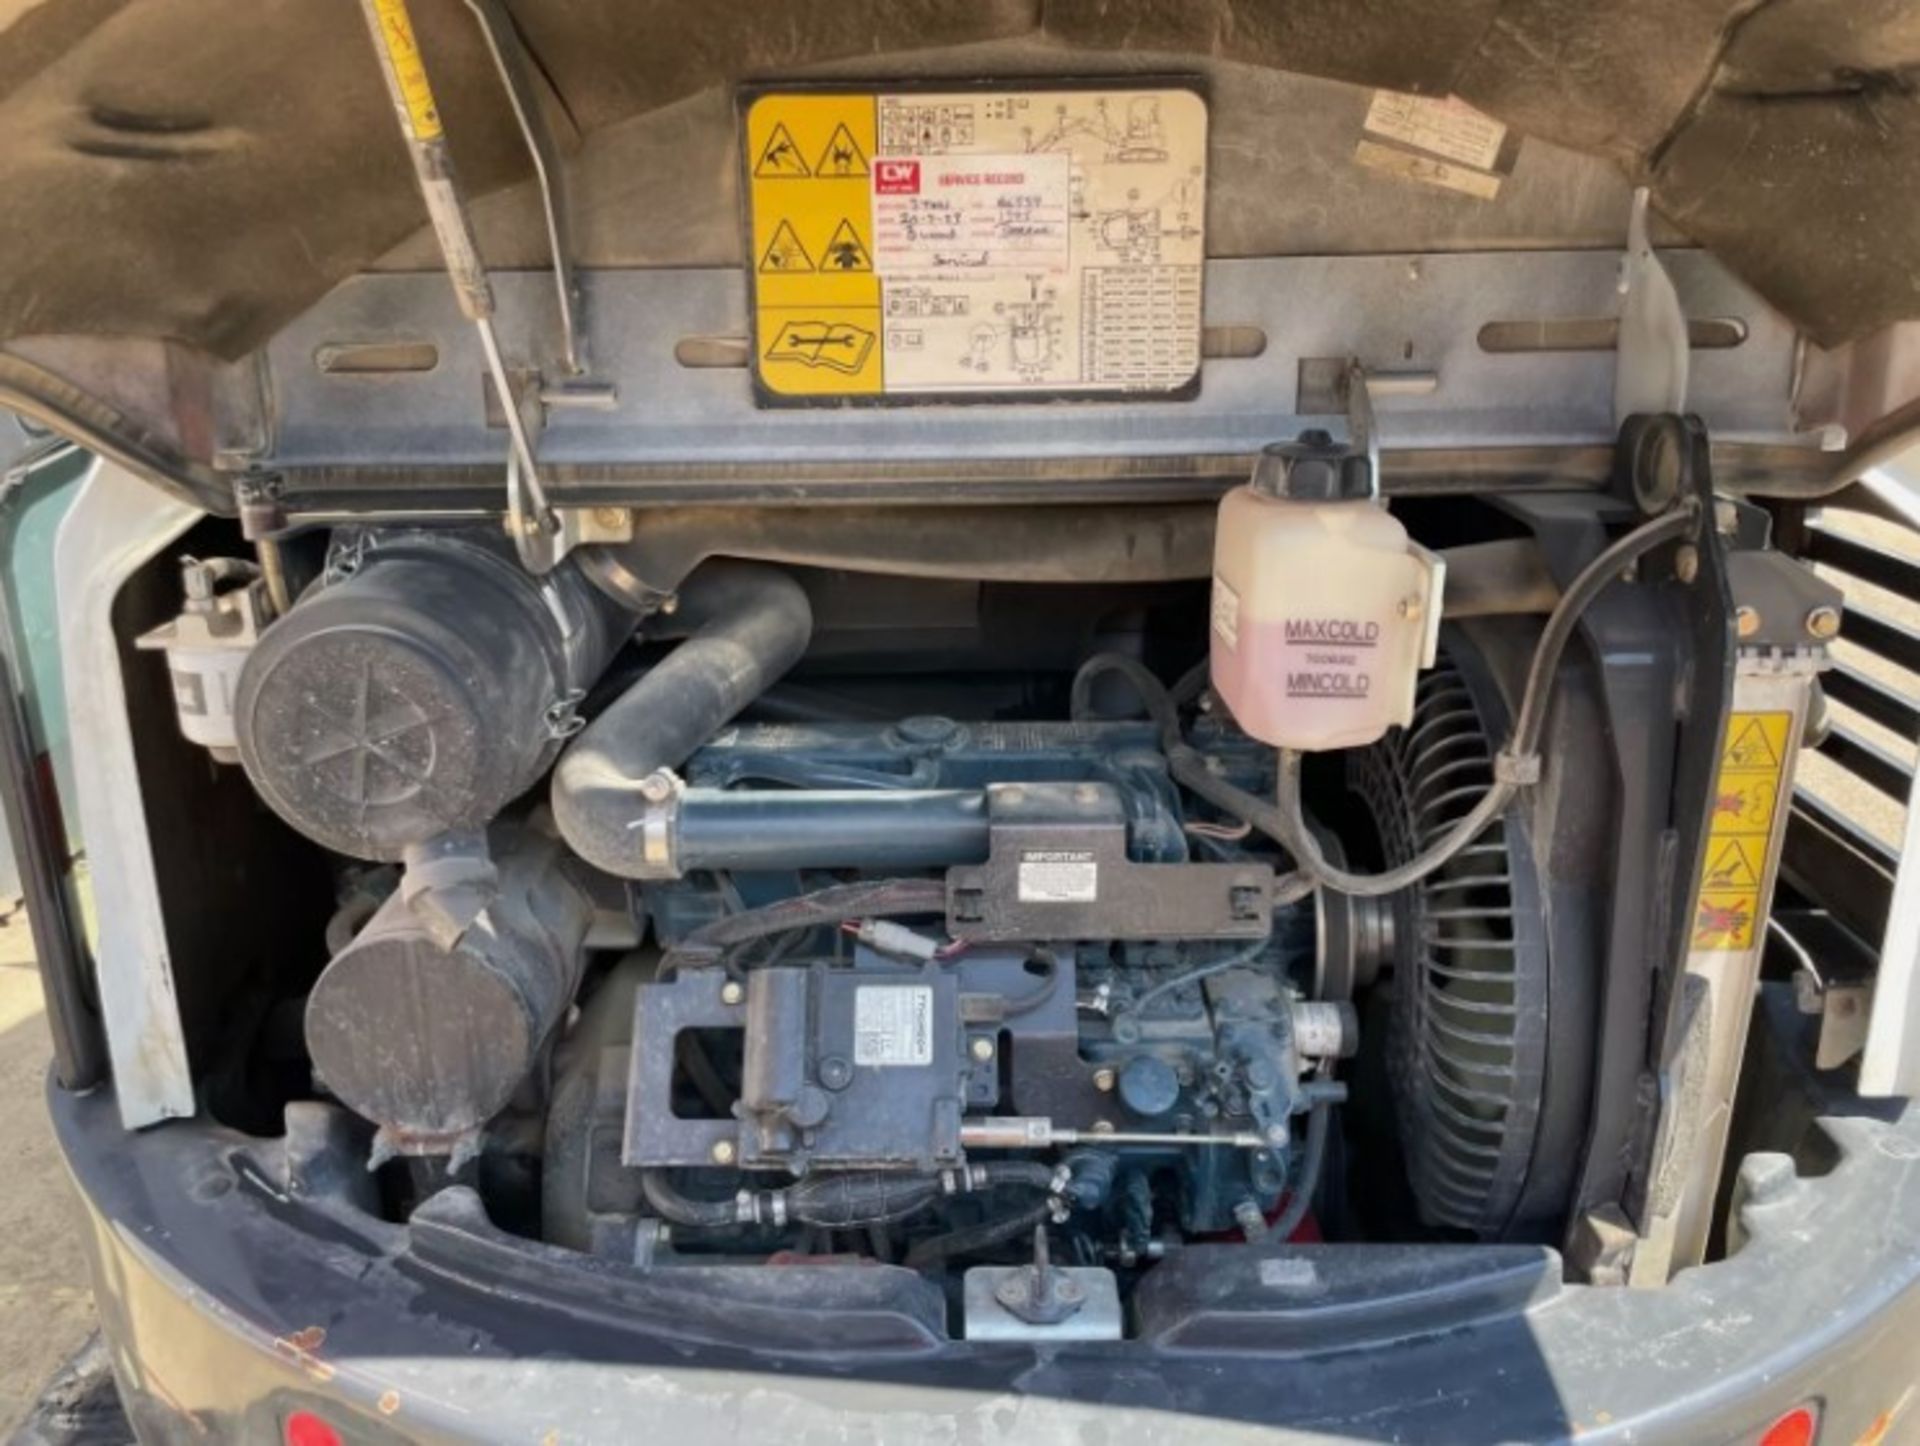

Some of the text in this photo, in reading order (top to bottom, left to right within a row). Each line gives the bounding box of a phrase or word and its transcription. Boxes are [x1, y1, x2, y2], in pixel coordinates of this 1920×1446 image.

[938, 173, 1025, 186] SERVICE RECORD
[1285, 618, 1379, 640] MAXCOLD
[1286, 672, 1370, 692] MINCOLD
[1023, 851, 1094, 862] IMPORTANT
